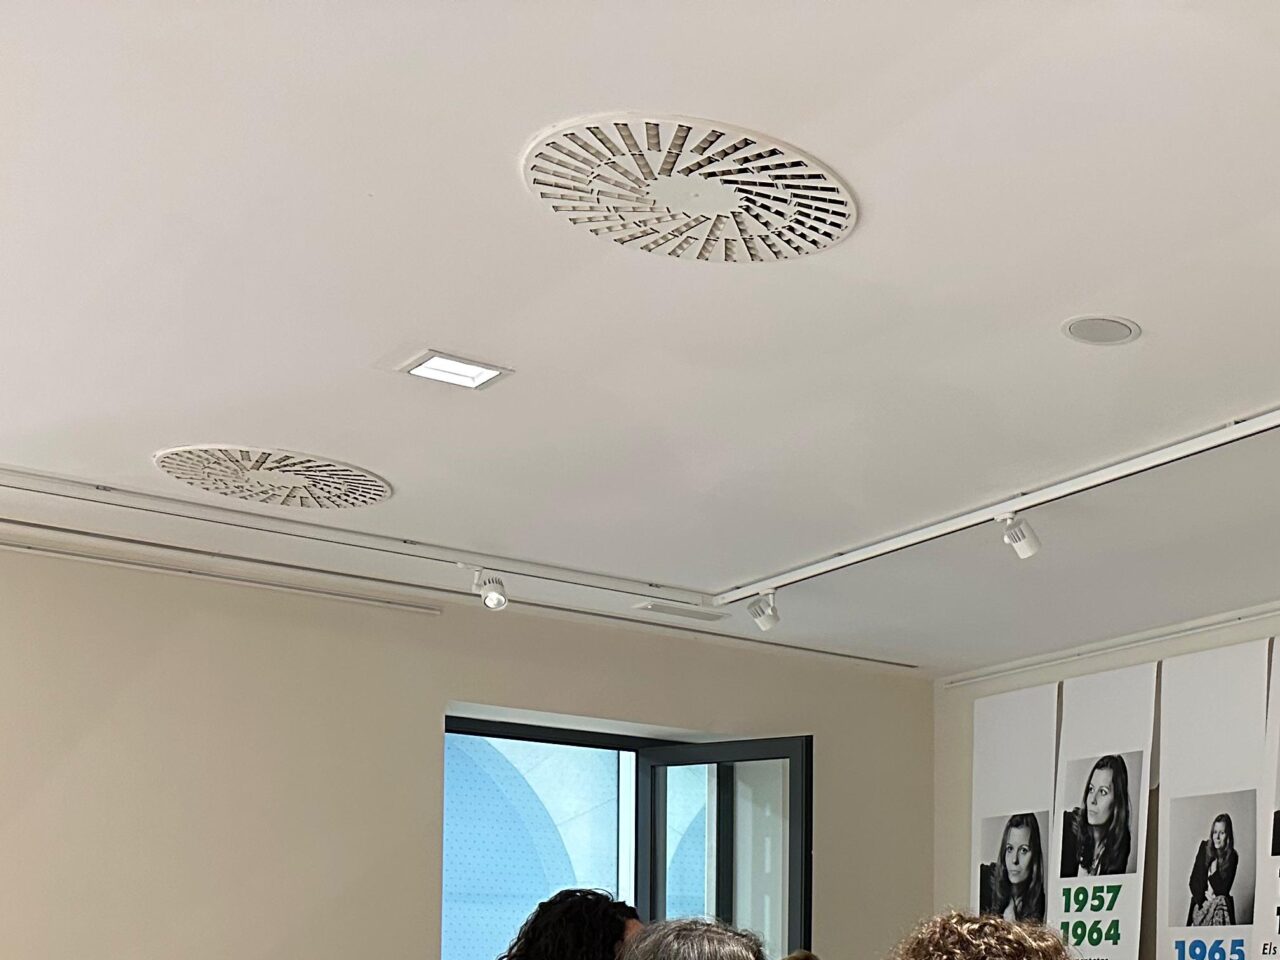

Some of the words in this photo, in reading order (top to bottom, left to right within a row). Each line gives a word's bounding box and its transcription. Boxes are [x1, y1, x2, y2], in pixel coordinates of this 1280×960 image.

[1062, 884, 1122, 913] 1957
[1060, 919, 1121, 947] 1964
[1262, 942, 1277, 955] Els
